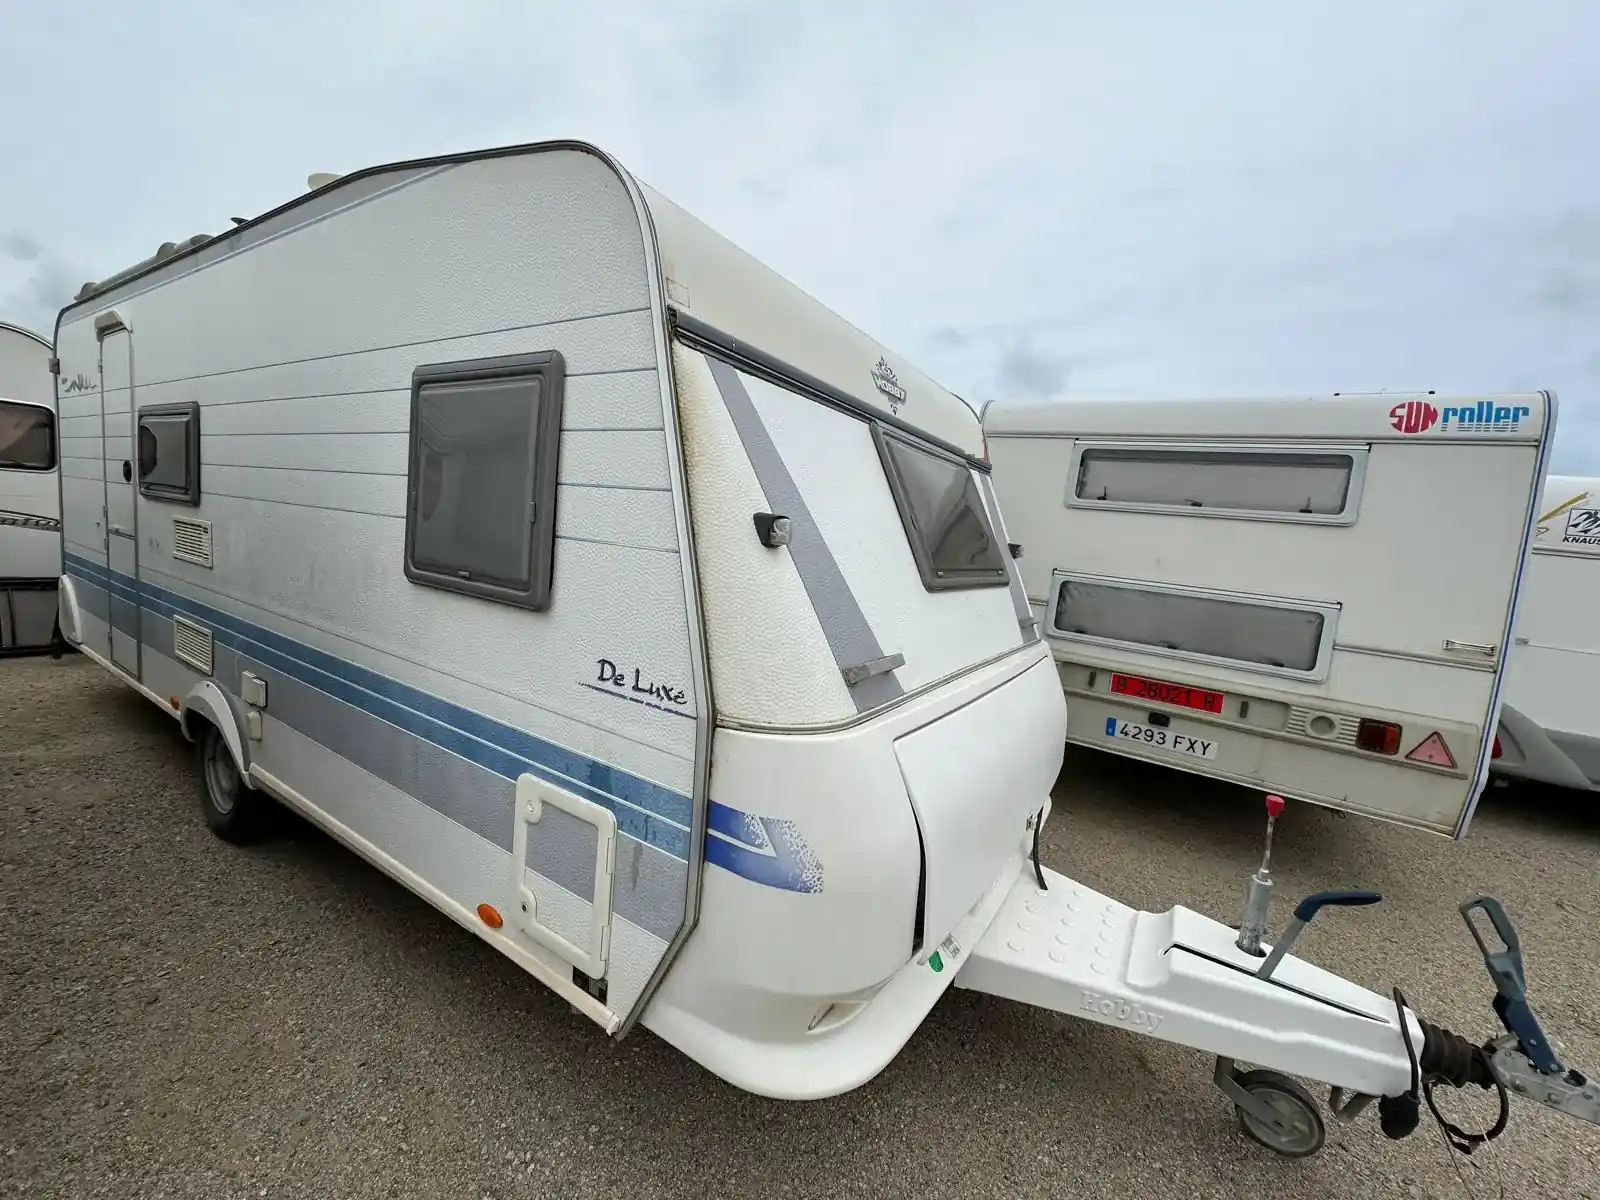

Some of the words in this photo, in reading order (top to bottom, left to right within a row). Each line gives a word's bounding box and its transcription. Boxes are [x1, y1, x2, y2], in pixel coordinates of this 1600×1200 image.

[872, 374, 906, 400] HOBBY
[1389, 401, 1439, 433] SUN
[1440, 401, 1530, 432] roller
[597, 658, 626, 687] De
[1136, 680, 1191, 703] 28021
[1120, 723, 1167, 746] 4293
[1173, 735, 1212, 756] FXY
[1080, 990, 1164, 1033] Hobby
